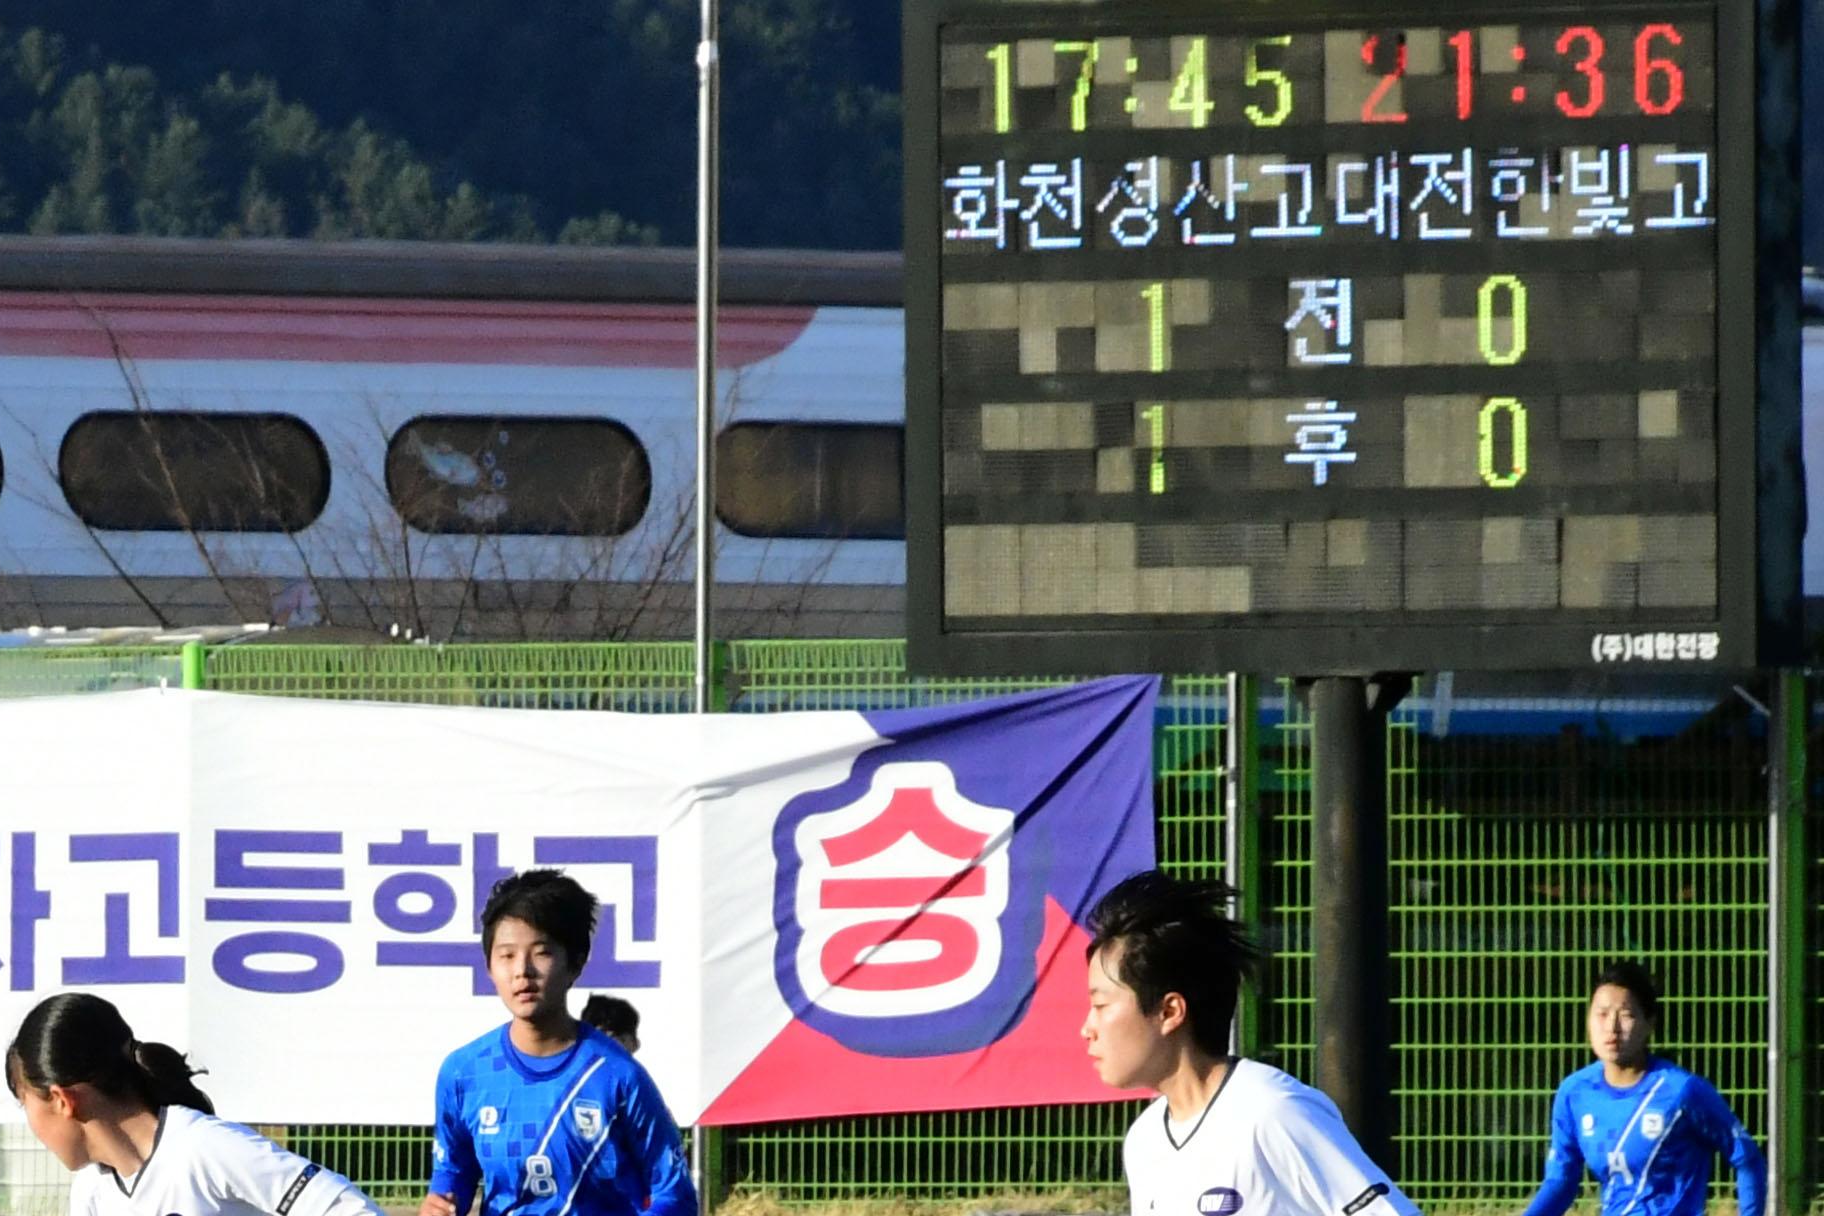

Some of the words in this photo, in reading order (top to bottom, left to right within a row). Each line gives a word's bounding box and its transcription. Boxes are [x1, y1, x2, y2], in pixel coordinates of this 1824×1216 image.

[986, 36, 1292, 132] 17:45
[1361, 23, 1685, 123] 21:36
[1140, 282, 1164, 373] 1
[1283, 277, 1352, 364] 전
[1477, 274, 1527, 366] 0
[1140, 405, 1165, 494] 1
[1284, 400, 1357, 487] 후
[1478, 397, 1527, 488] 0
[819, 787, 990, 991] 승
[526, 1154, 558, 1197] 8
